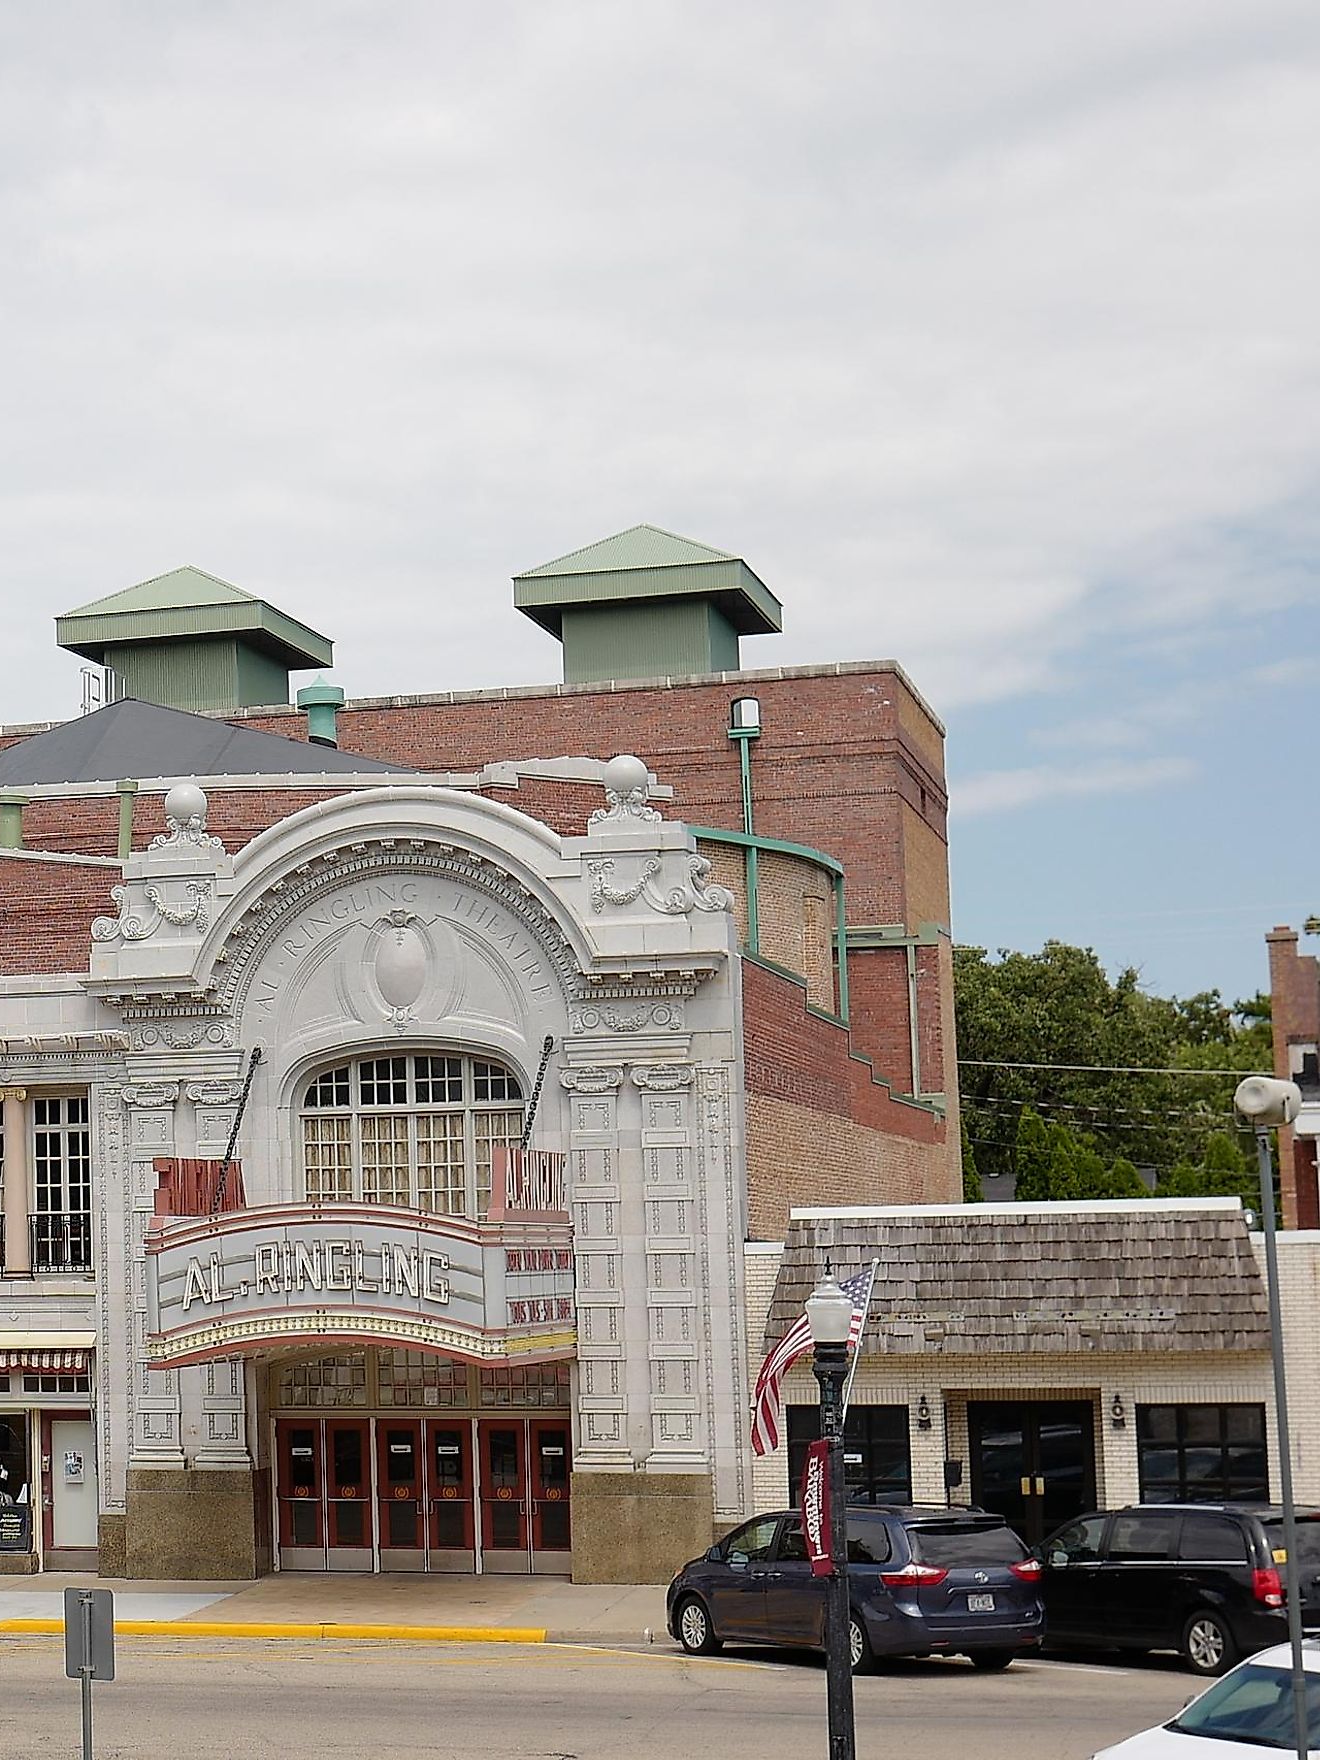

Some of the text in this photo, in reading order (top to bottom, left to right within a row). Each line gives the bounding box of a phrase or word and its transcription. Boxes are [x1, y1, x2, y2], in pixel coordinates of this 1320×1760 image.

[254, 883, 554, 1012] AL RINGLING THEATRE
[255, 1239, 450, 1305] RINGLING
